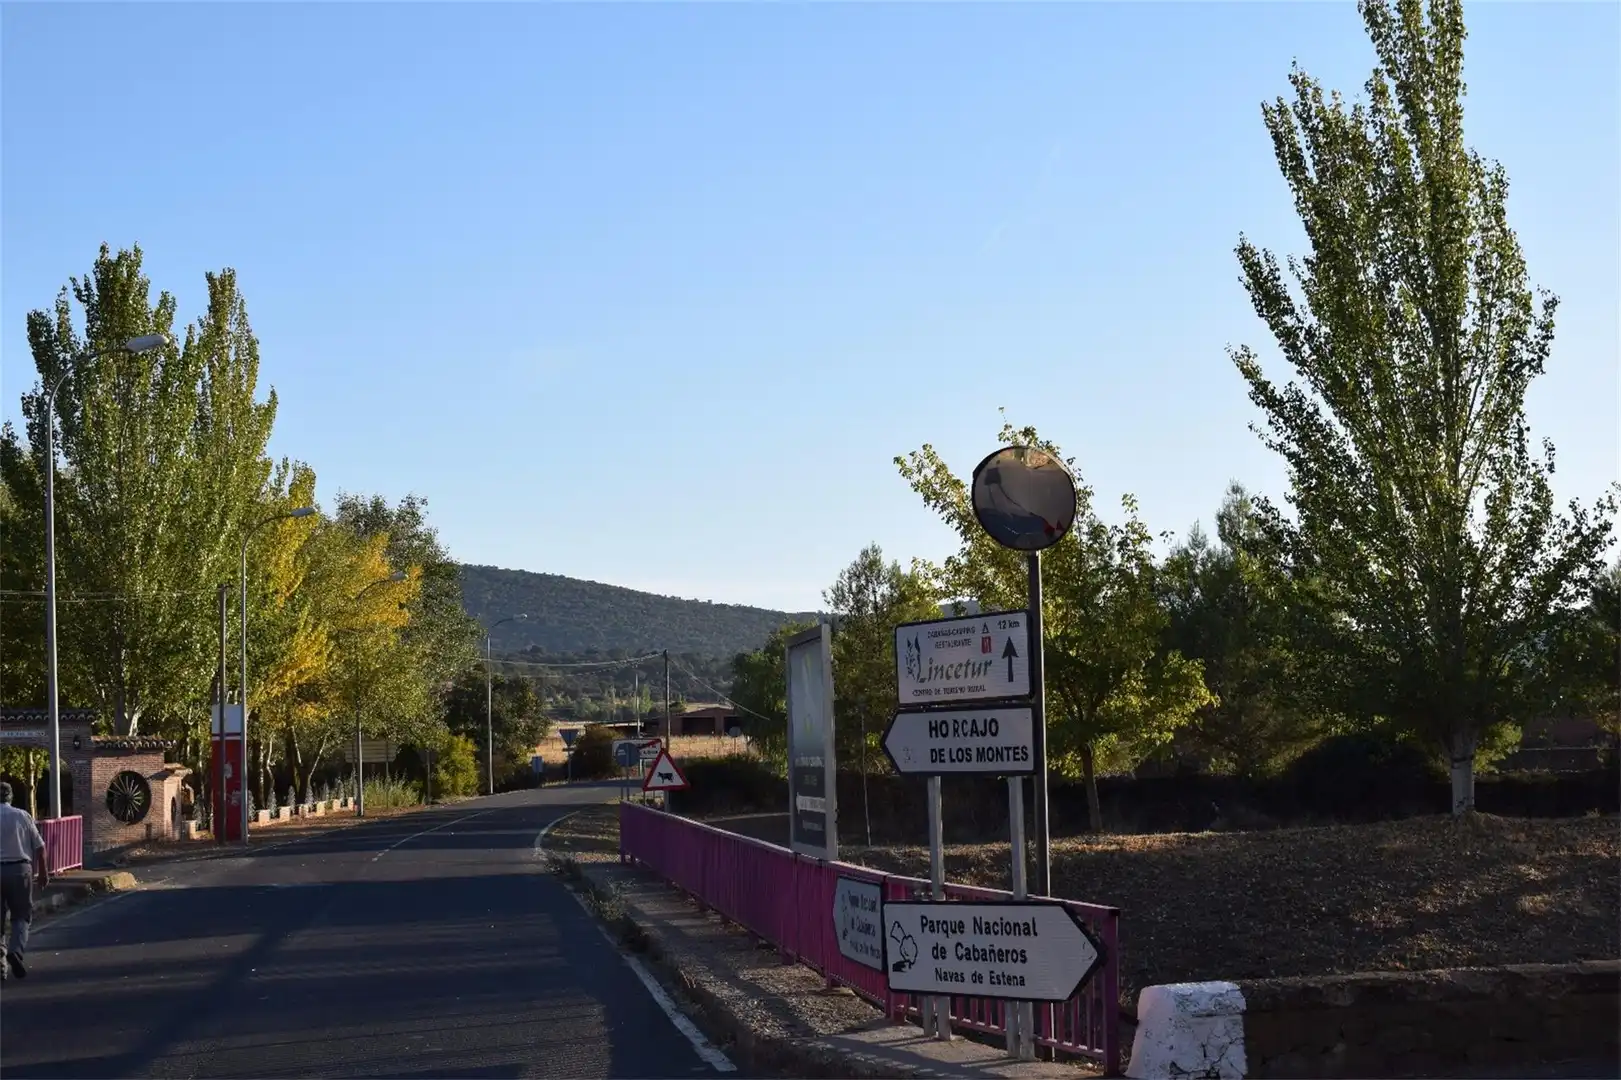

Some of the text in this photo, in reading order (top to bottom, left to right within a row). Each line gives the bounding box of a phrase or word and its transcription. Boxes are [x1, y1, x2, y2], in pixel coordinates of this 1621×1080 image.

[998, 619, 1020, 630] 12 km
[935, 638, 972, 649] RESTAURANTE
[912, 688, 933, 697] CENTRO
[934, 687, 942, 696] DE
[928, 717, 999, 738] HORCAJO
[930, 745, 1029, 764] DE LOS MONTES
[920, 915, 1038, 938] Parque Nacional
[931, 942, 1028, 964] de Cabañeros
[934, 967, 1026, 987] Navas de Estena
